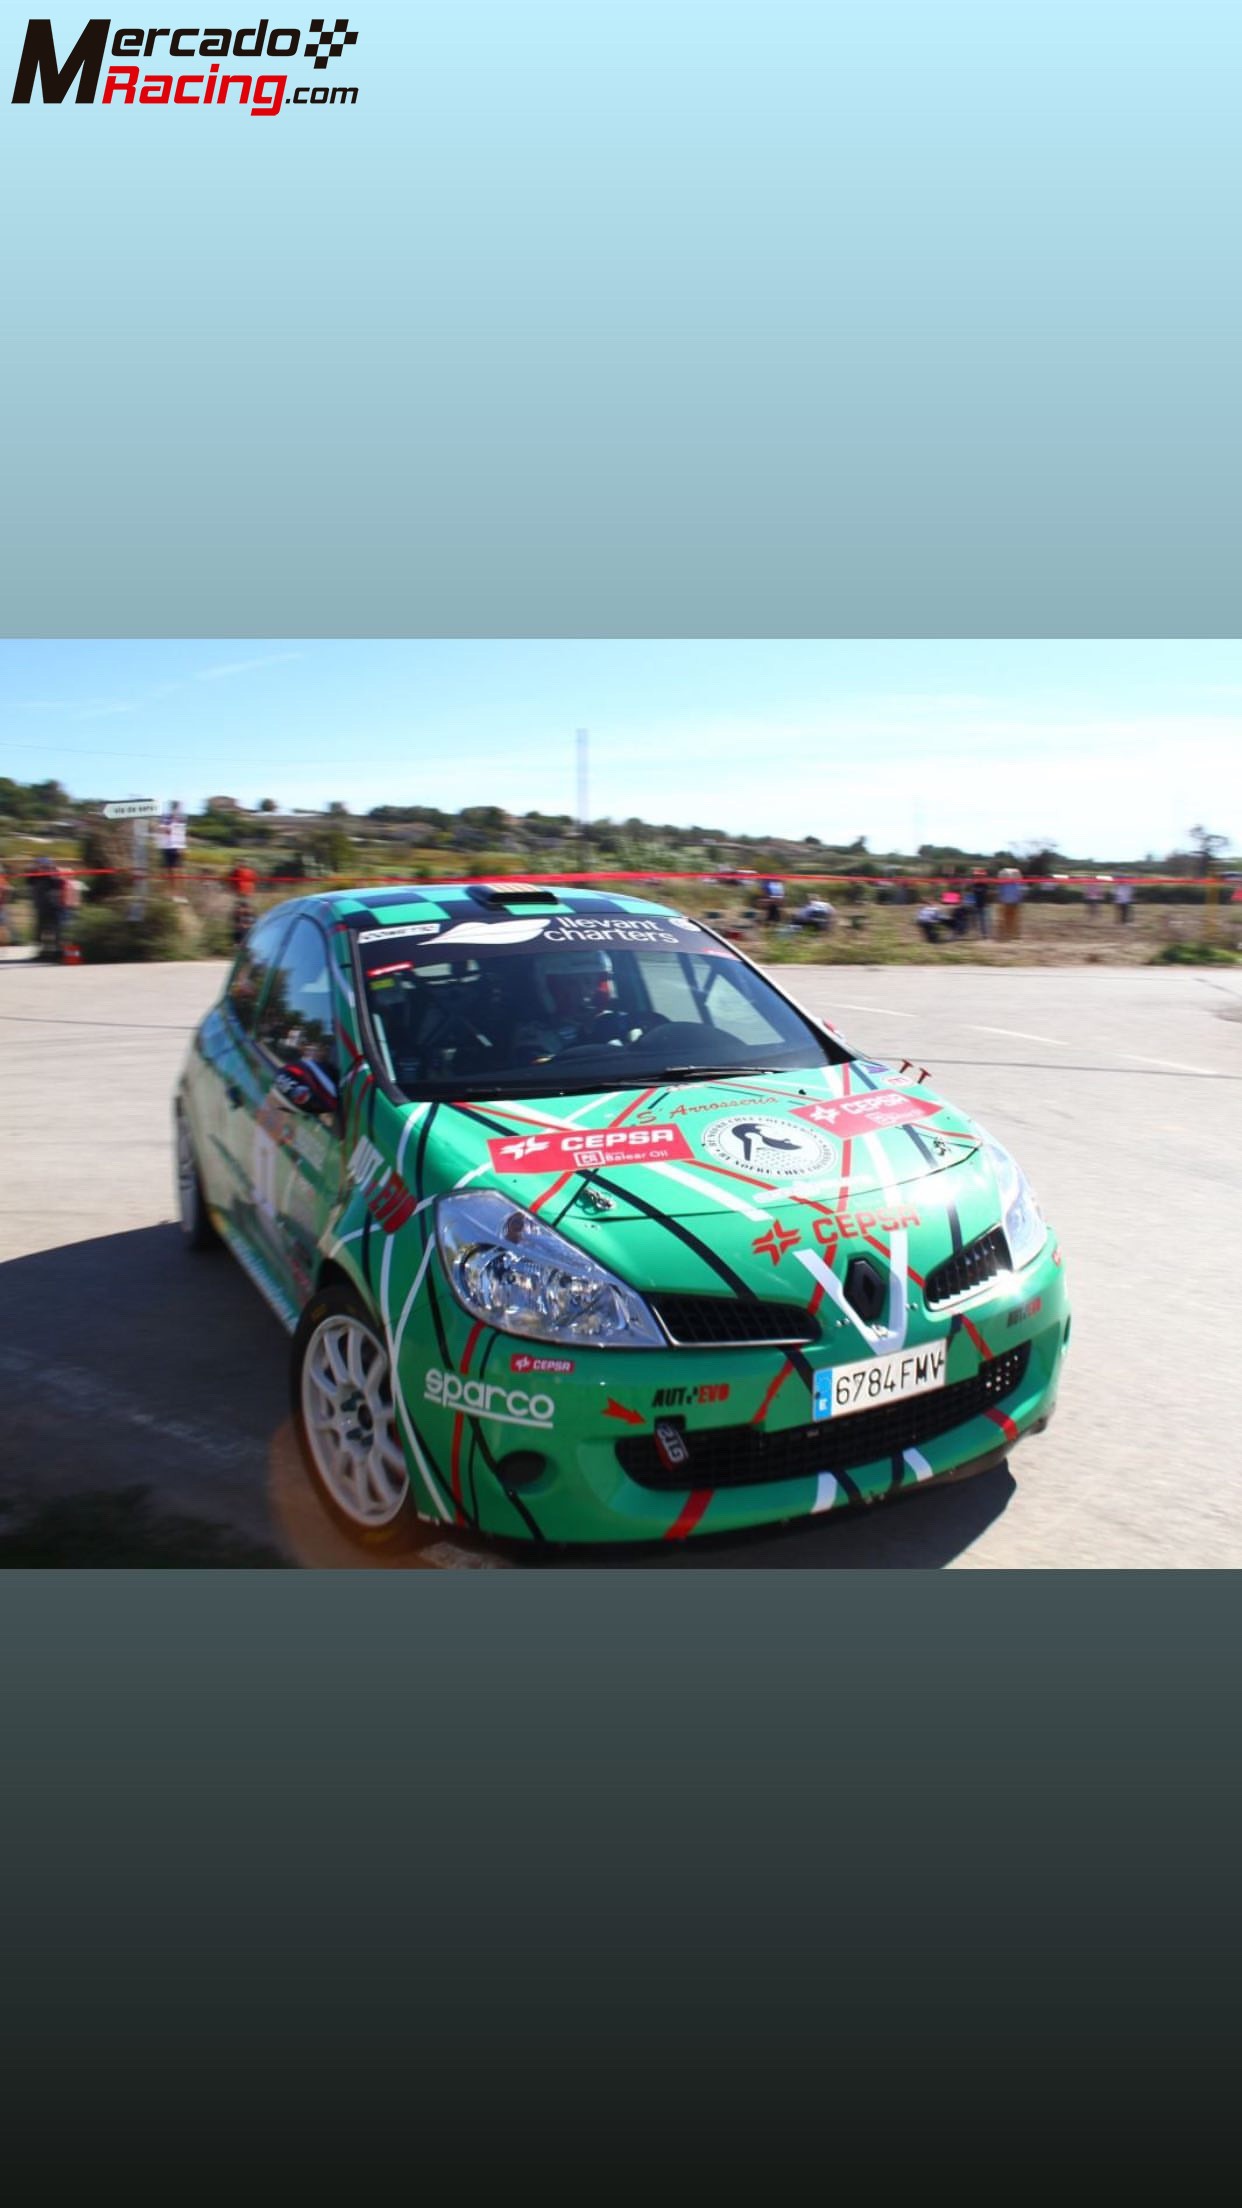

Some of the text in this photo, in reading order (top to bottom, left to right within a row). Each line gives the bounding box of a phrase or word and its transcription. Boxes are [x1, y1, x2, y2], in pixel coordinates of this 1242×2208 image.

[544, 926, 679, 944] charters
[556, 917, 662, 931] llevant
[561, 1129, 675, 1152] CEPSA
[812, 1204, 921, 1245] CEPSA
[532, 1358, 572, 1373] CEPSA
[836, 1352, 945, 1406] 6784 FMV
[424, 1368, 555, 1420] sparco
